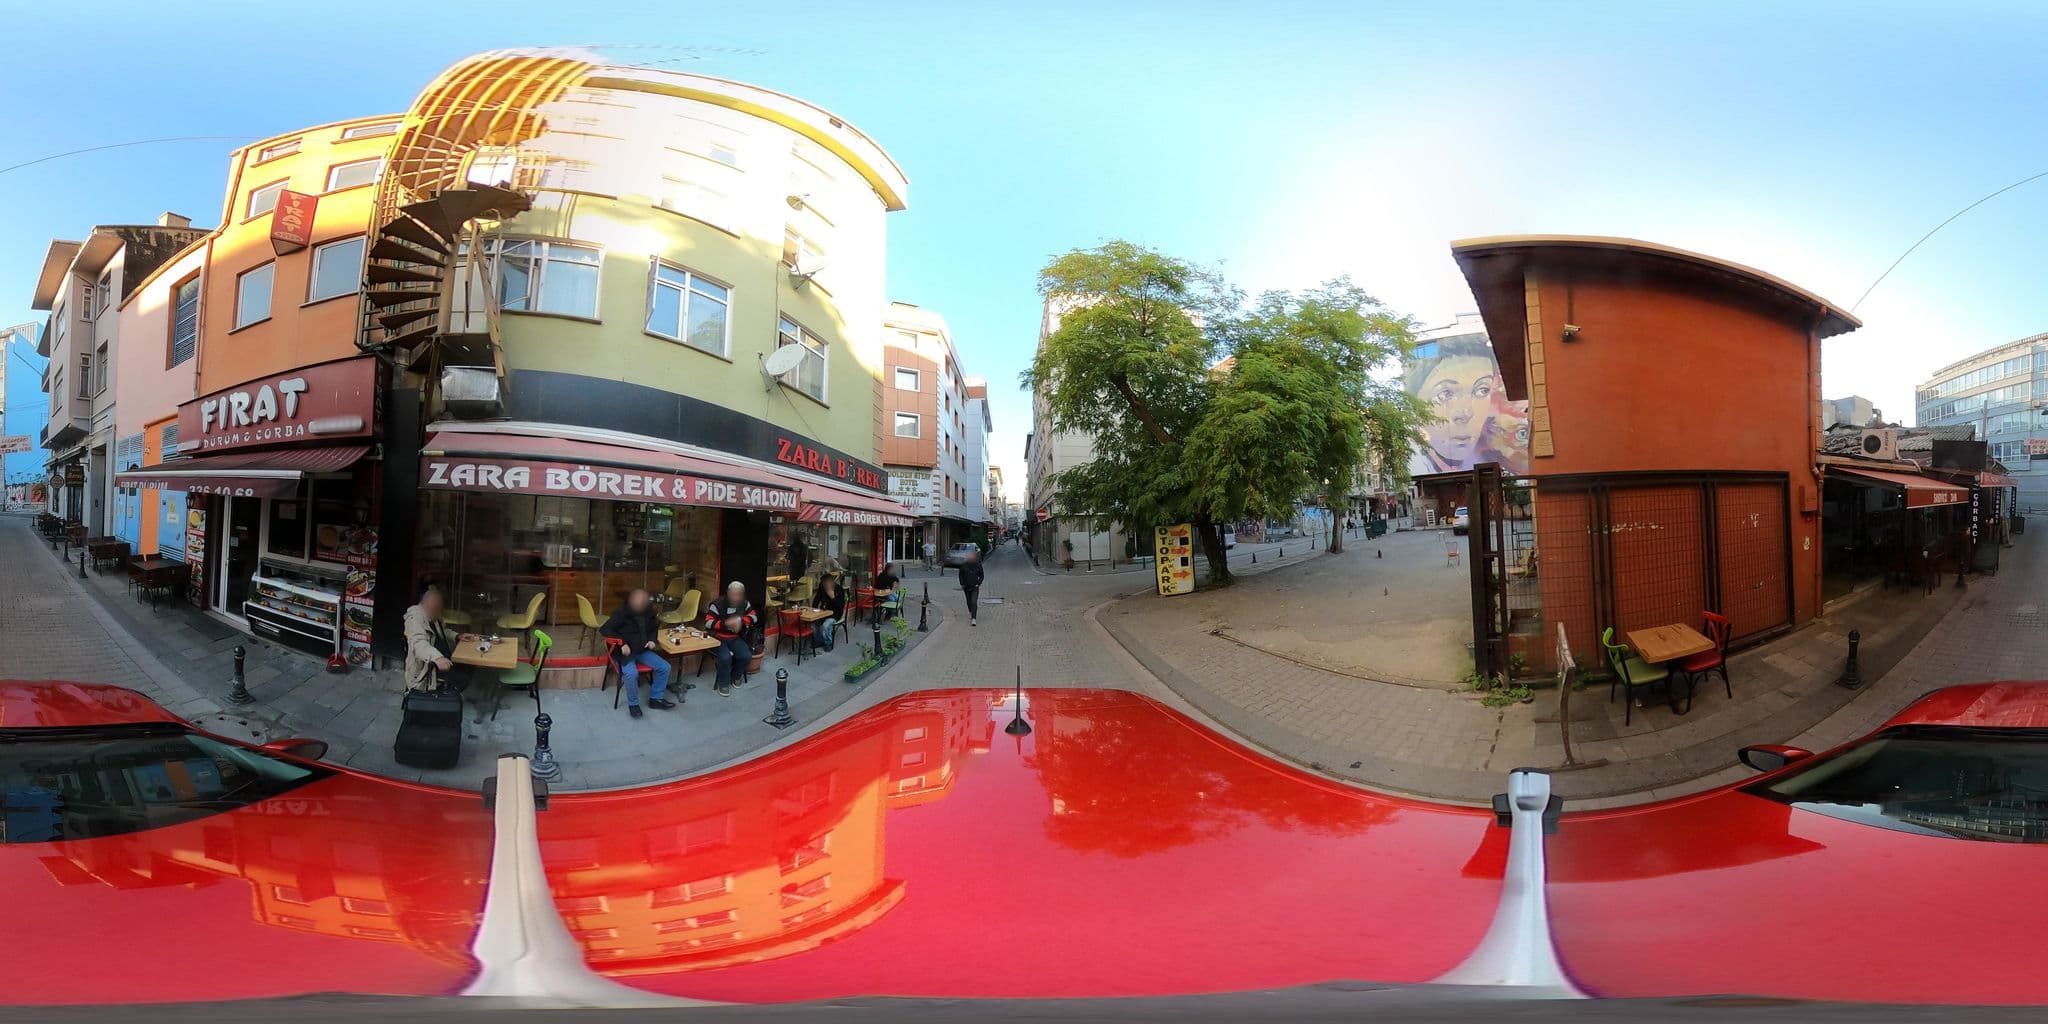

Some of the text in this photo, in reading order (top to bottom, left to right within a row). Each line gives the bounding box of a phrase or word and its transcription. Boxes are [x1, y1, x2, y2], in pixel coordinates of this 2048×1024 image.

[201, 377, 308, 434] FIRAT
[428, 463, 531, 490] ZARA
[545, 465, 666, 498] BÖREK
[672, 478, 688, 500] &
[743, 487, 797, 509] SALONU
[777, 437, 880, 489] ZARA BÖREK
[819, 508, 850, 523] ZARA
[854, 511, 881, 525] BÖREK
[1158, 527, 1172, 593] OTOPARK
